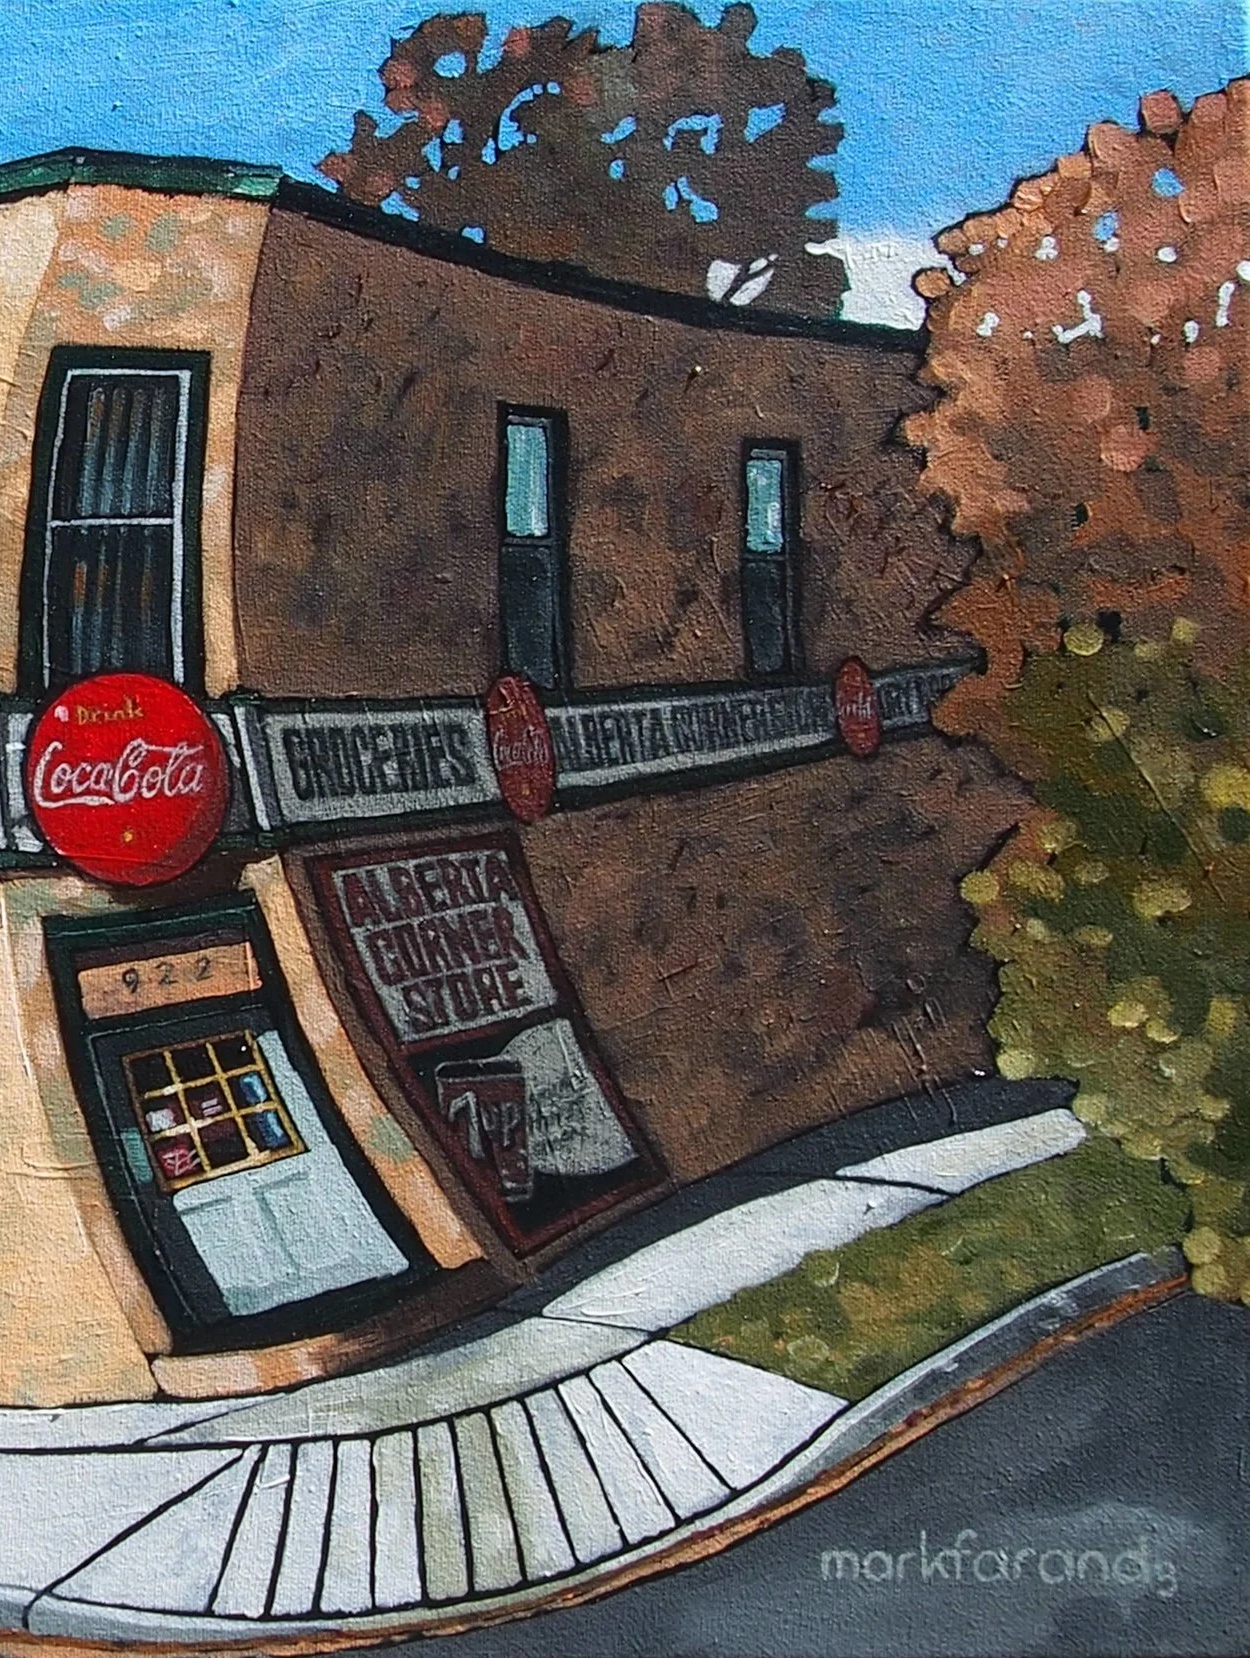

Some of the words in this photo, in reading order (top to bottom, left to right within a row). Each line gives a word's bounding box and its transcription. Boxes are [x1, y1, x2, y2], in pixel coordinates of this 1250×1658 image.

[75, 695, 144, 726] Drink
[283, 721, 477, 801] GROCERIES
[341, 854, 521, 928] ALBERTA
[367, 905, 532, 986] CORNER
[402, 960, 534, 1034] STORE
